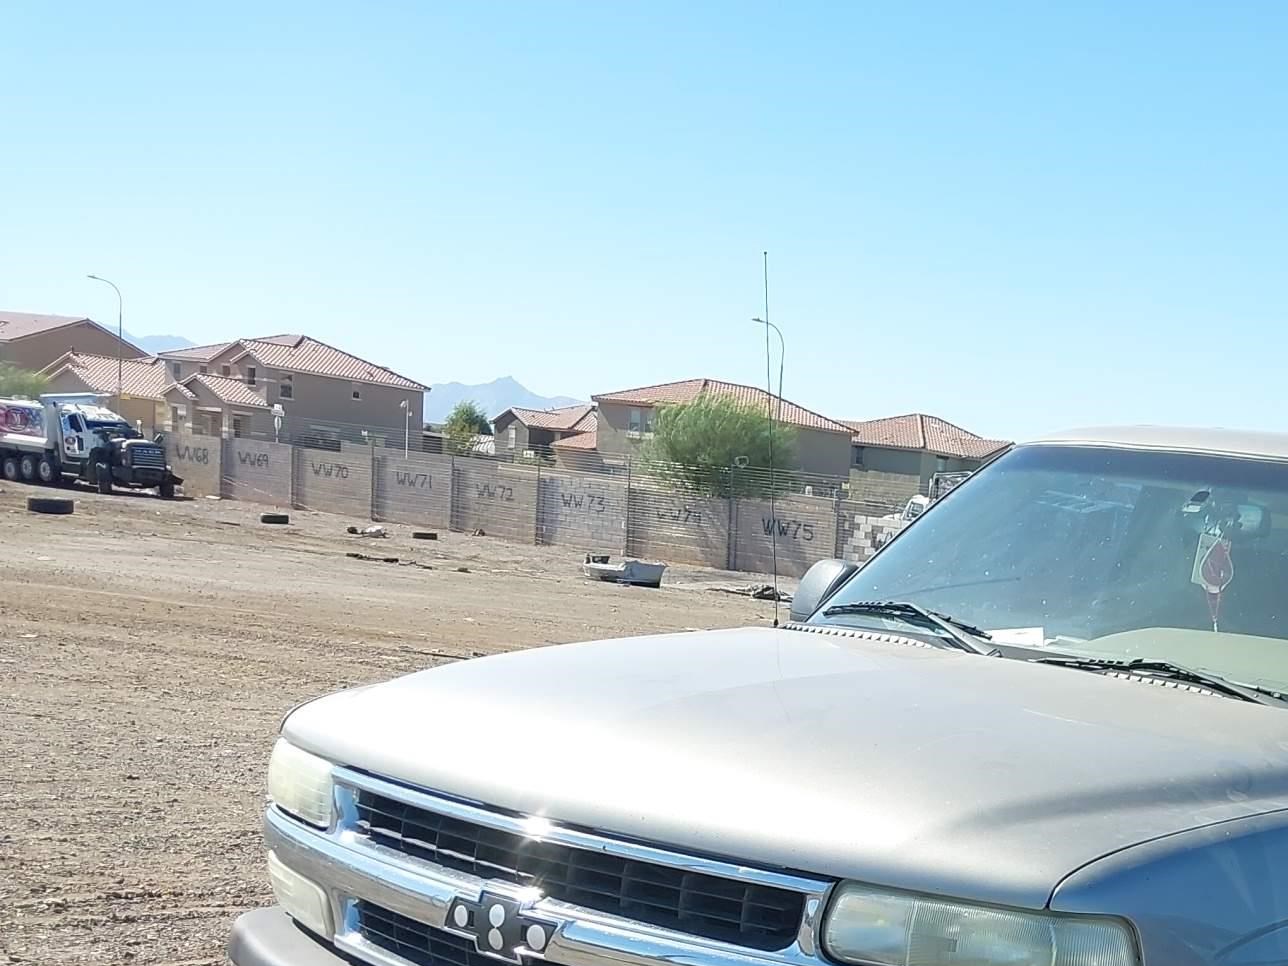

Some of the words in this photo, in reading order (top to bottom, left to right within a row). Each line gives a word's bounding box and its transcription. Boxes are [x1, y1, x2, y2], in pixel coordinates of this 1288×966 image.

[176, 446, 209, 465] WW68
[238, 450, 269, 467] WW69
[311, 462, 349, 479] WW70
[396, 471, 432, 489] WW71
[476, 482, 514, 501] WW72
[561, 493, 605, 513] WW73
[761, 517, 815, 541] WW75
